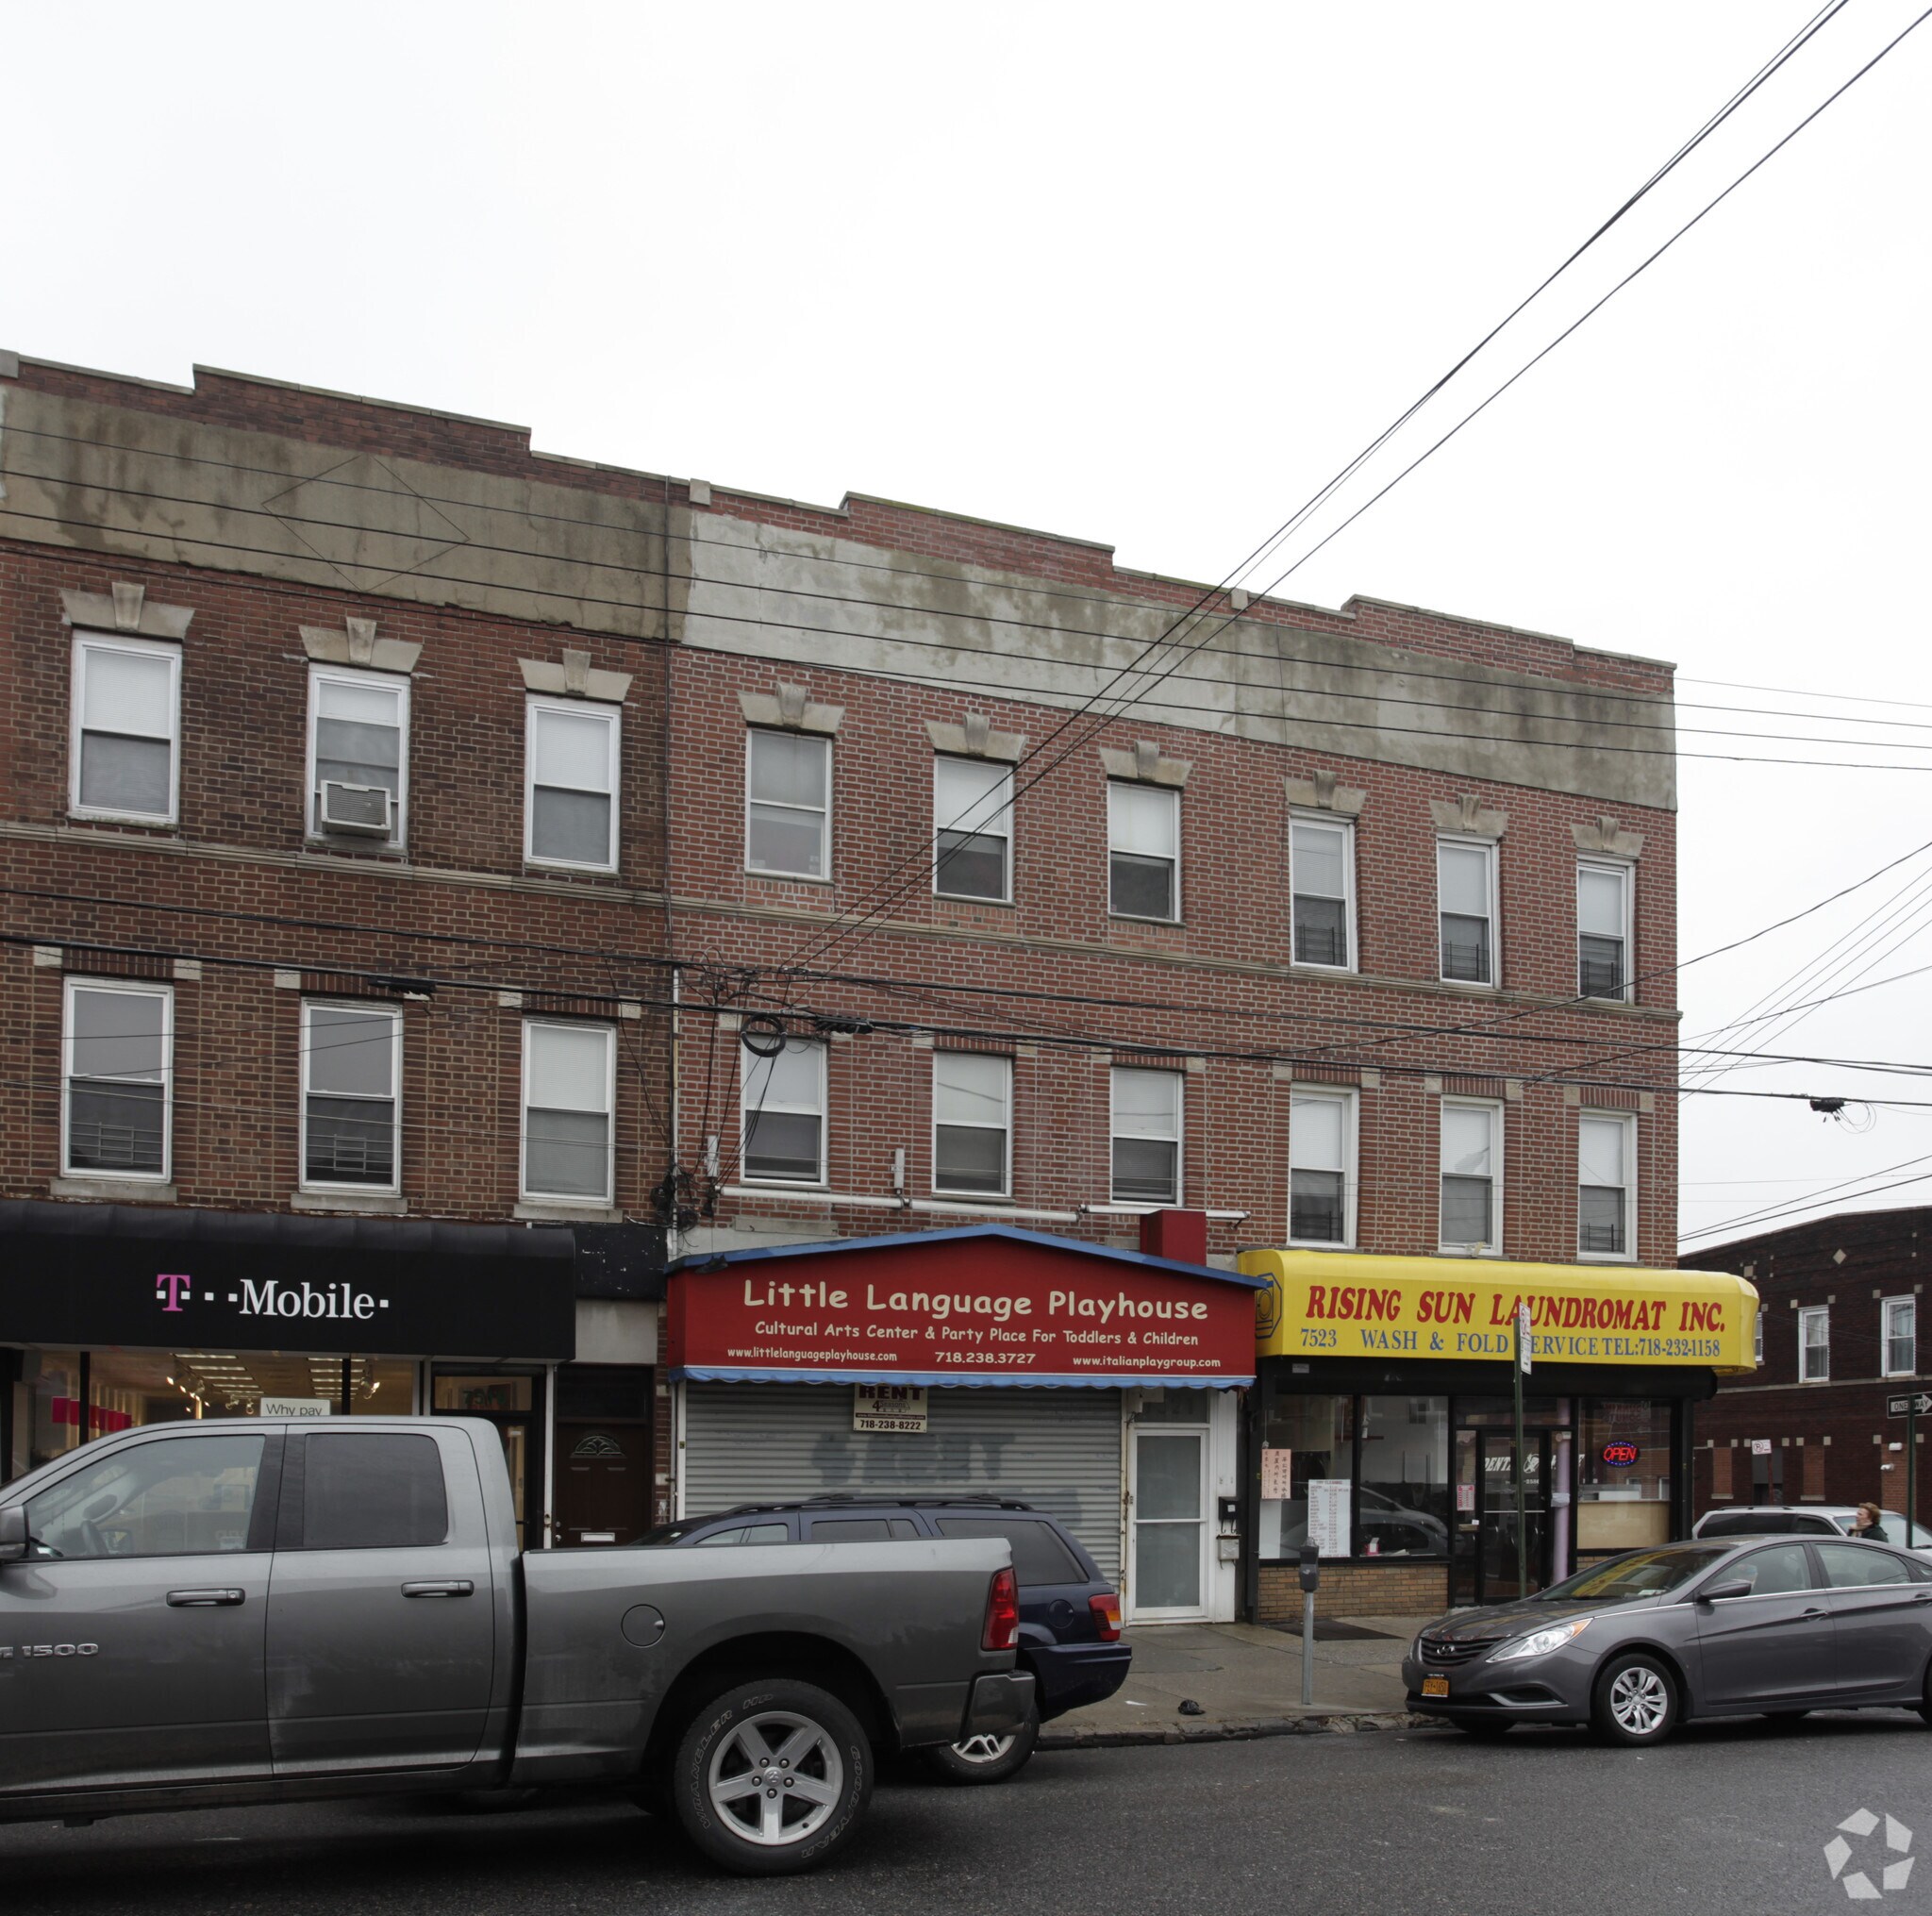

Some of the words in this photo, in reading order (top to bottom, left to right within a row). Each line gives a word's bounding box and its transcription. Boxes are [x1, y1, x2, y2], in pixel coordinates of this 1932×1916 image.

[743, 1279, 849, 1308] Little
[866, 1284, 1033, 1322] Language
[1048, 1291, 1208, 1325] Playhouse
[1305, 1285, 1401, 1322] RISING
[1416, 1291, 1475, 1325] SUN
[1678, 1301, 1725, 1333] INC.
[755, 1321, 818, 1336] Cultural
[824, 1324, 860, 1338] Arts
[866, 1325, 918, 1339] Center
[924, 1326, 936, 1340] &
[941, 1326, 984, 1344] Party
[990, 1328, 1027, 1342] Place
[1032, 1329, 1057, 1342] For
[1063, 1330, 1122, 1344] Toddlers
[1127, 1332, 1138, 1345] &
[1142, 1332, 1199, 1346] Children
[1300, 1327, 1337, 1347] 7523
[1360, 1328, 1418, 1351] WASH
[1429, 1331, 1444, 1352] &
[1457, 1332, 1508, 1354] FOLD
[1529, 1336, 1599, 1356] ERVICE
[1602, 1337, 1721, 1358] TEL:718-232-1158
[727, 1347, 897, 1362] www.littlelanguageplayhouse.com
[935, 1352, 1036, 1364] 718.238.3727
[1073, 1356, 1222, 1369] www.italianplaygroup.com
[266, 1403, 295, 1415] Why
[860, 1420, 921, 1430] 718-238-8222
[1604, 1447, 1637, 1461] OPEN
[22, 1643, 99, 1658] 1500
[801, 1745, 863, 1858] GOODYEAR
